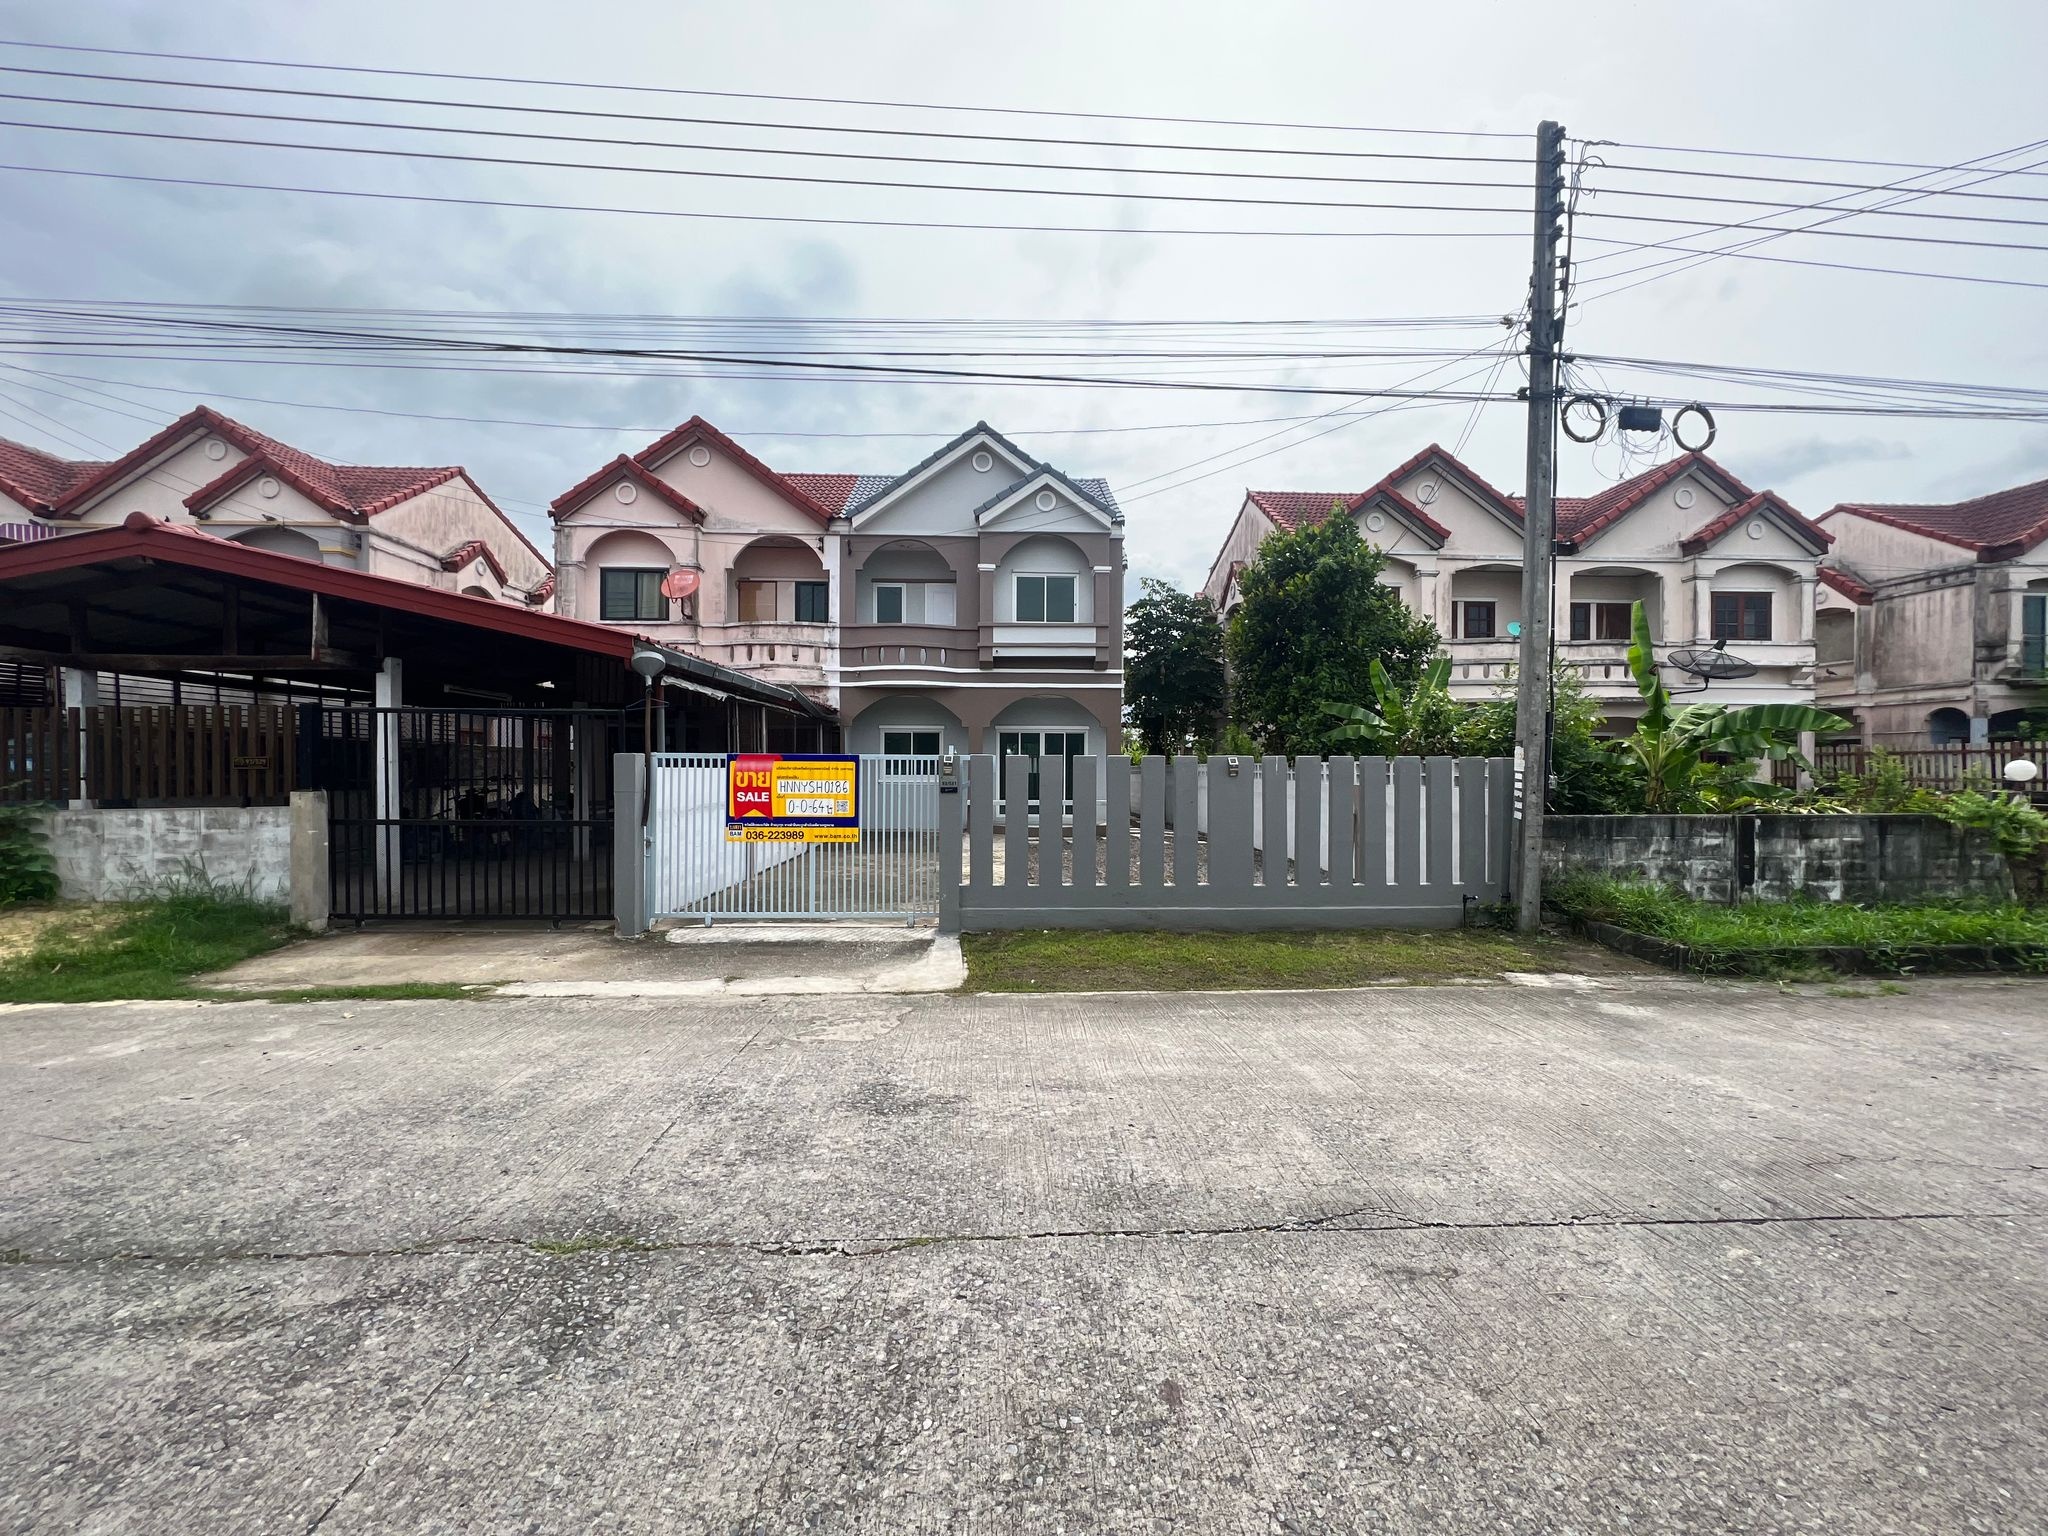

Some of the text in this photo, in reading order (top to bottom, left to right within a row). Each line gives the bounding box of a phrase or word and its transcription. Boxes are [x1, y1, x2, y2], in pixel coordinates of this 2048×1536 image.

[736, 771, 771, 787] ขาย
[780, 780, 848, 793] HNNYSH0186
[736, 791, 770, 802] SALE
[745, 830, 805, 840] 036-223989
